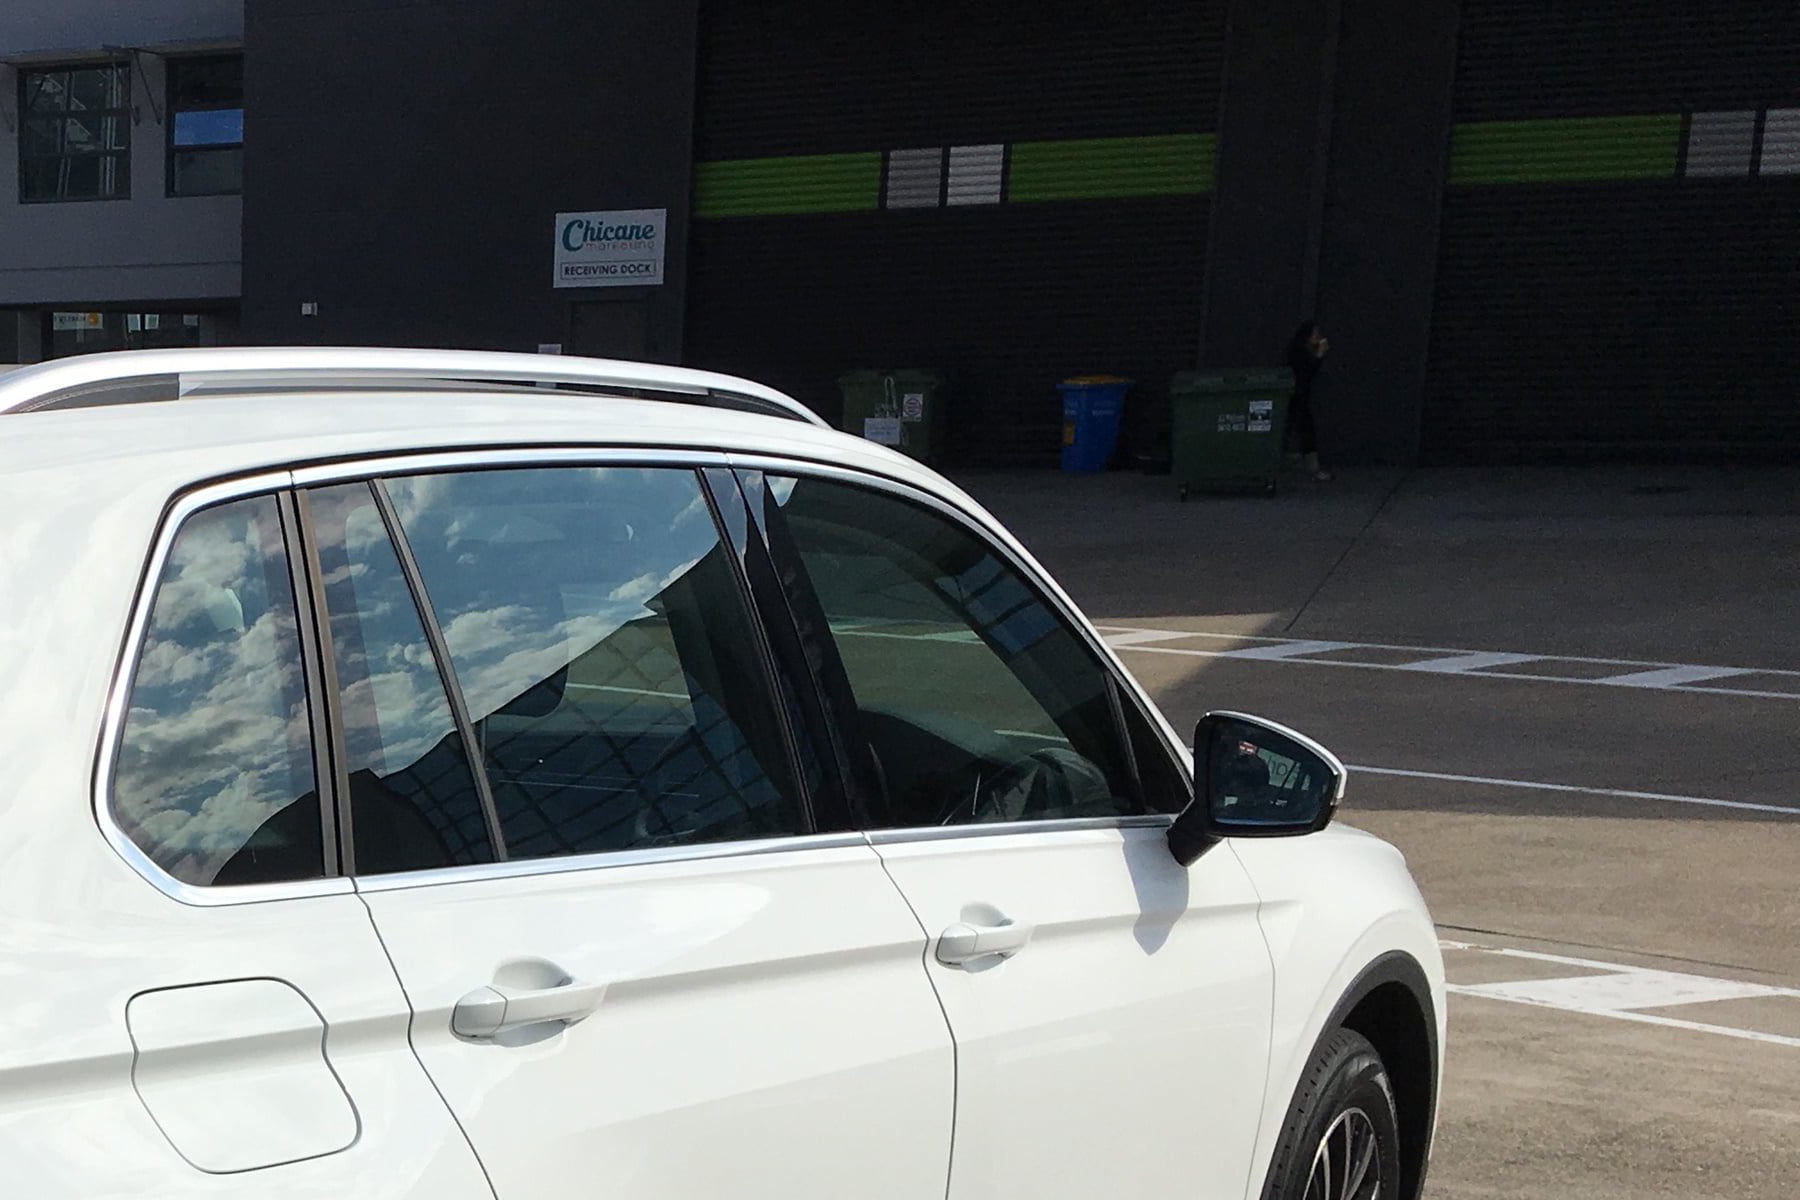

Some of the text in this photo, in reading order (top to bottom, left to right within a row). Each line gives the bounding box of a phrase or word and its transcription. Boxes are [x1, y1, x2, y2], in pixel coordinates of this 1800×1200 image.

[562, 218, 656, 252] Chicane
[564, 263, 651, 276] RECEIVING DOCK
